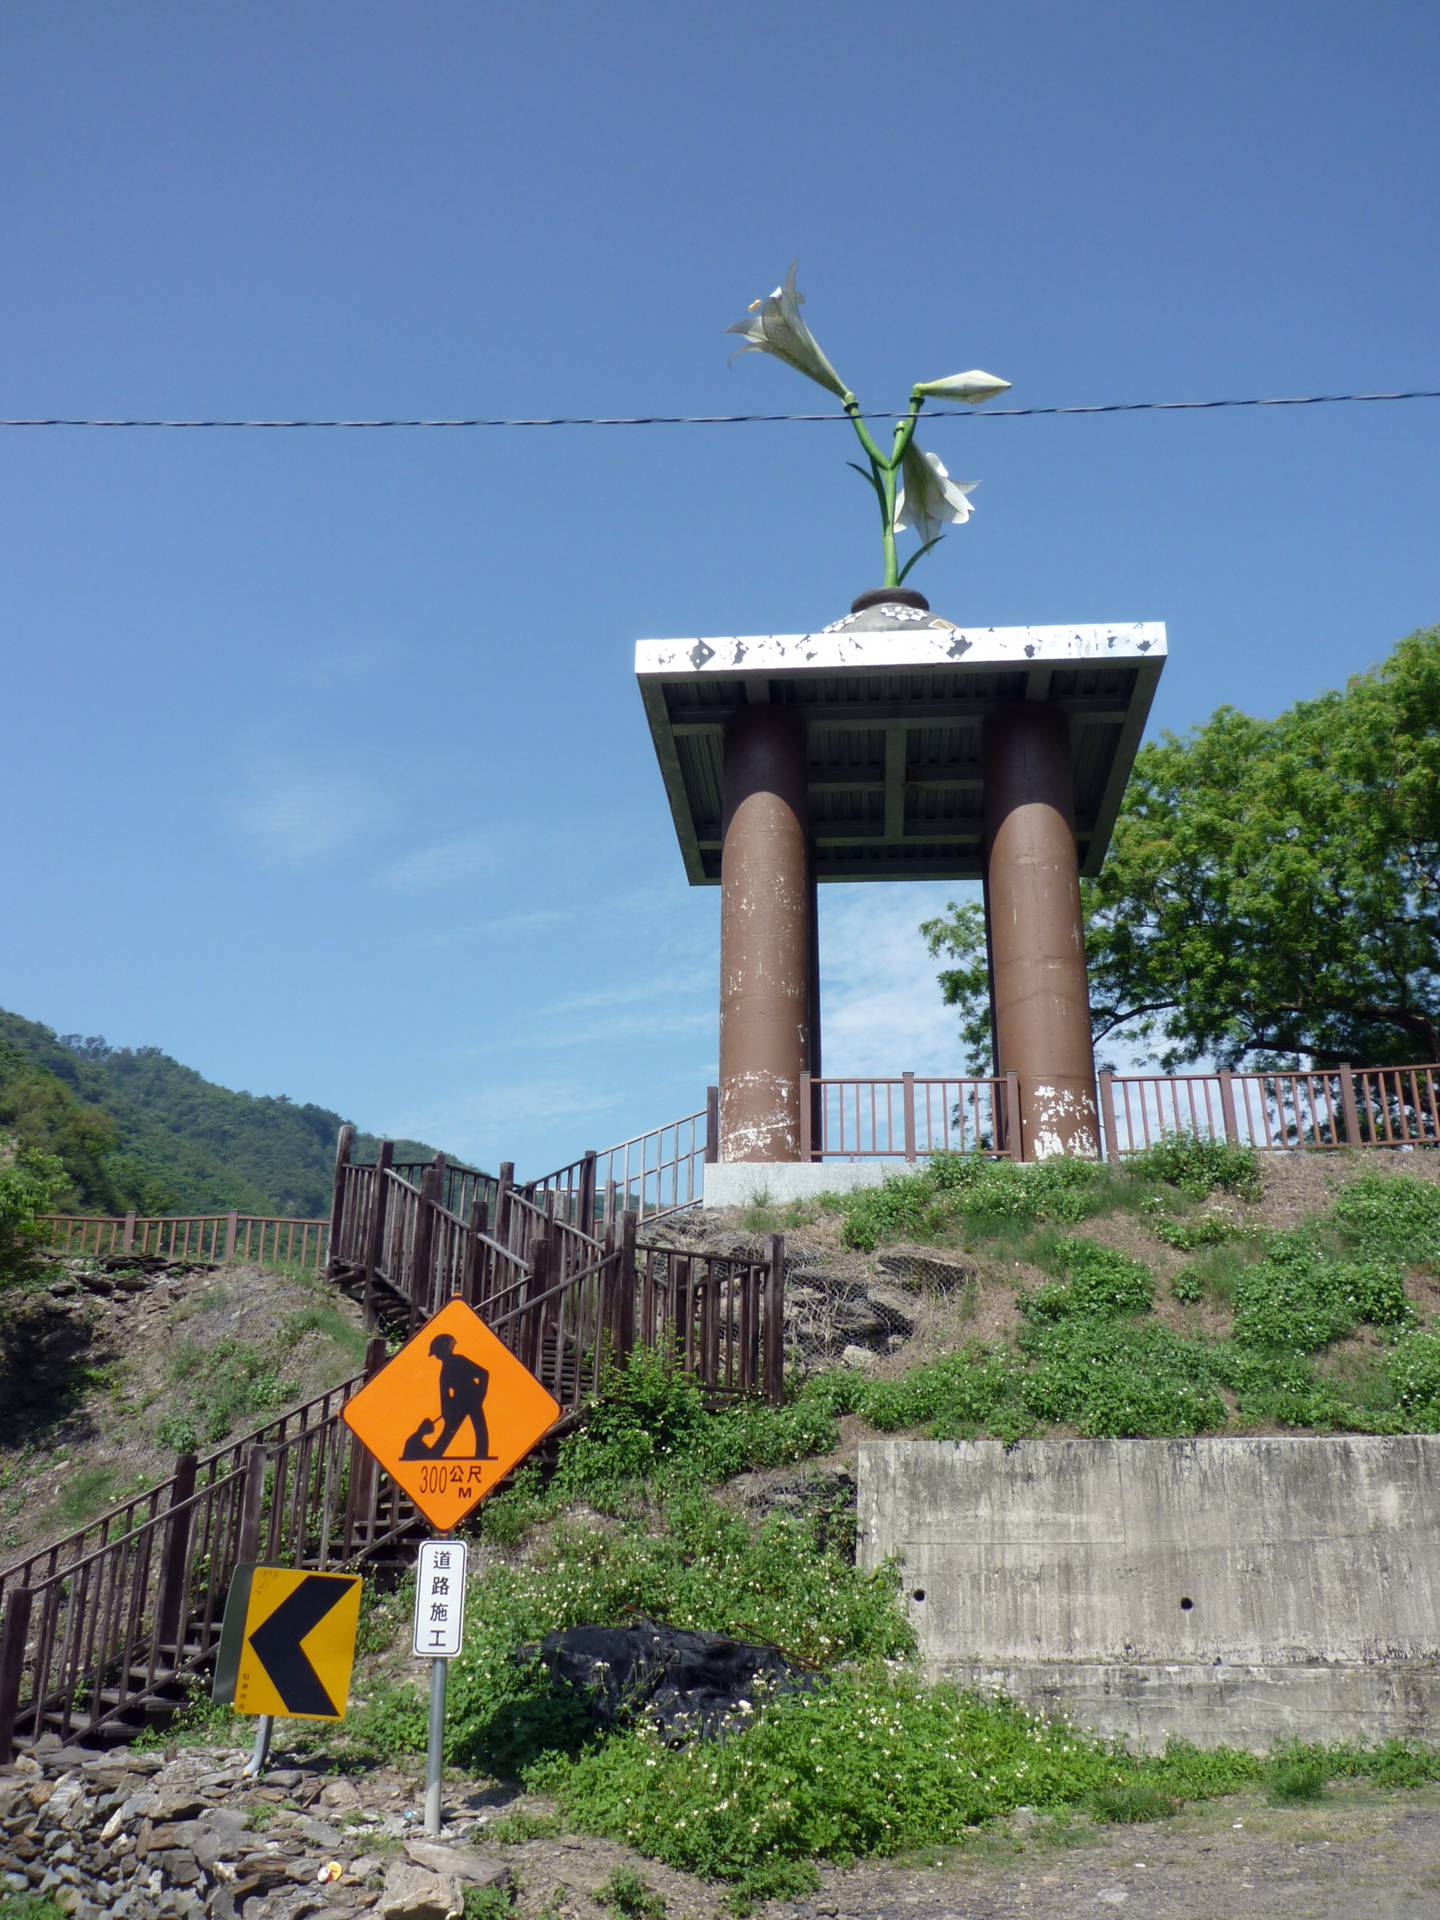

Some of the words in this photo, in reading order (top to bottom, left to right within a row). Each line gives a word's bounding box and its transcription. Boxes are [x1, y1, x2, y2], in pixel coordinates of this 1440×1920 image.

[420, 1465, 448, 1493] 300
[450, 1465, 482, 1483] 公尺
[458, 1487, 472, 1499] M
[428, 1551, 452, 1647] 道路施工
